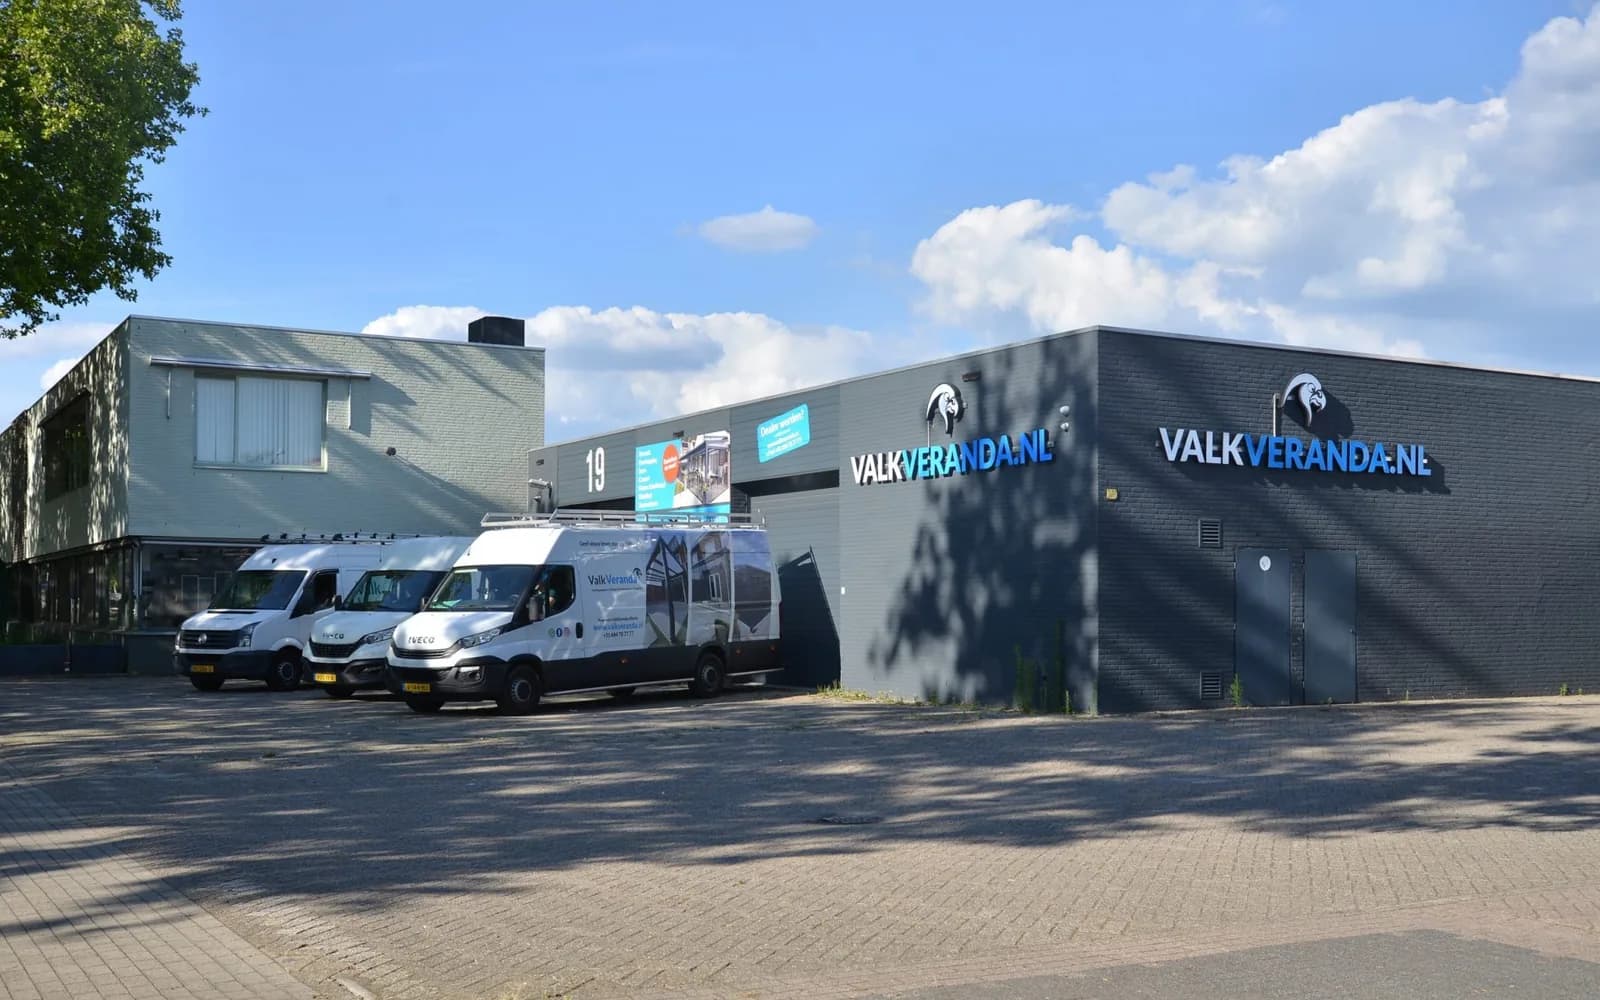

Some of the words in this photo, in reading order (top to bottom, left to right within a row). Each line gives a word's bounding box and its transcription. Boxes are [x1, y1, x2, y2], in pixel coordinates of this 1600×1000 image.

[586, 447, 605, 492] 19
[851, 428, 1053, 484] VALKVERANDA.NL
[1159, 427, 1432, 476] VALKVERANDA.NL
[408, 636, 435, 644] IVECO
